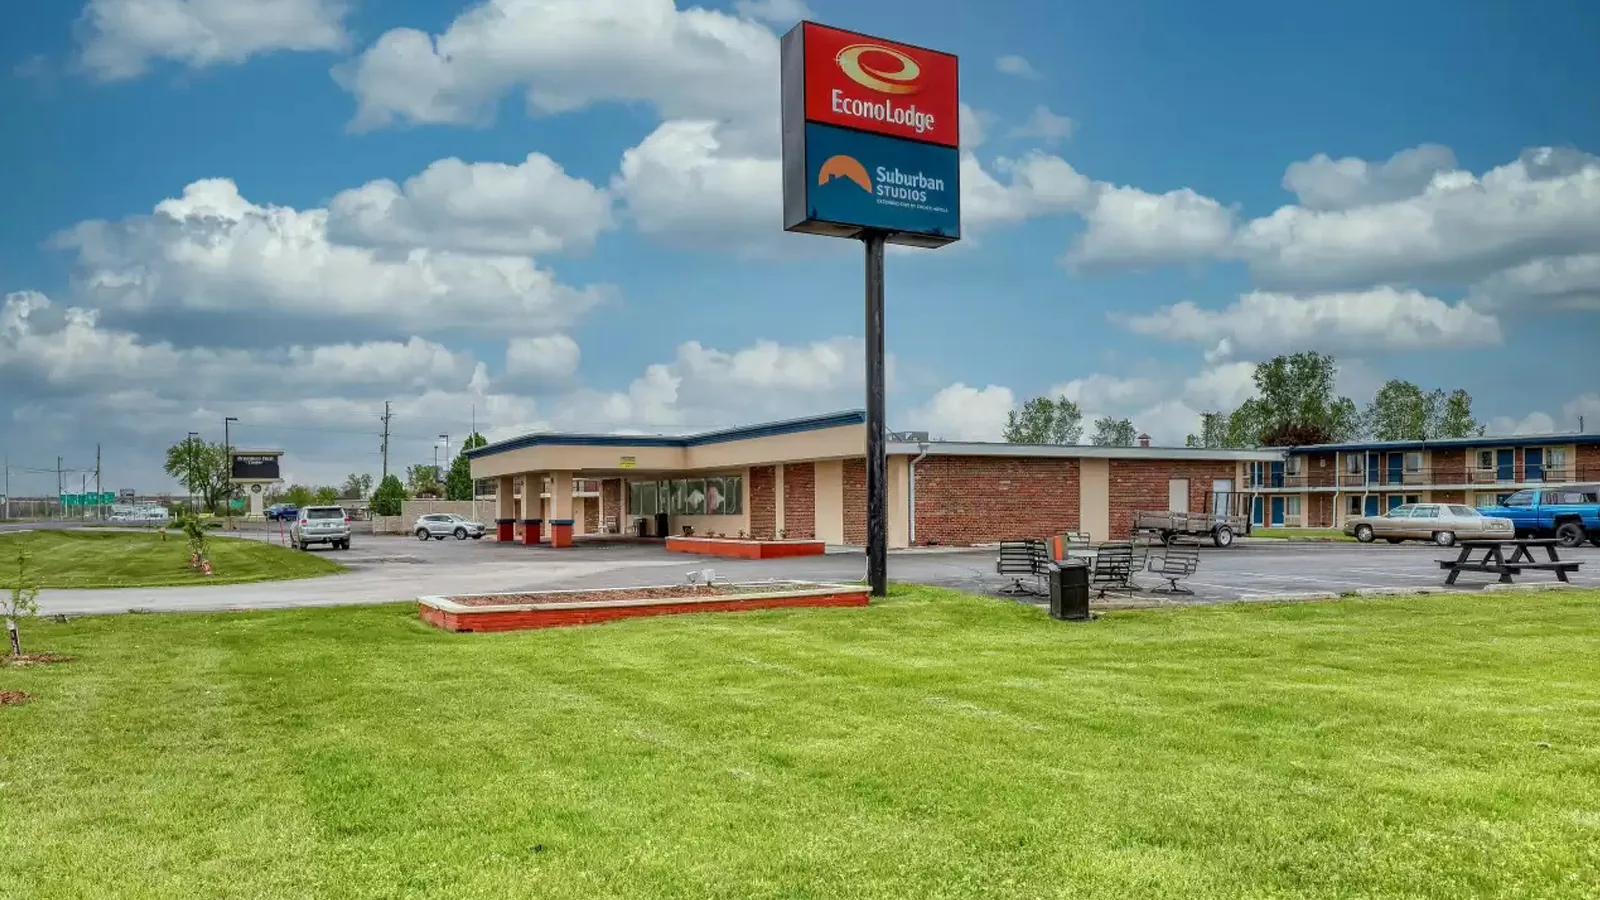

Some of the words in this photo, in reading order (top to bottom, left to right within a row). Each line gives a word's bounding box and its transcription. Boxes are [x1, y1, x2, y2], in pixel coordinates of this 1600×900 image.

[831, 88, 935, 133] EconoLodge
[876, 166, 945, 192] Suburban
[876, 184, 927, 203] STUDIOS
